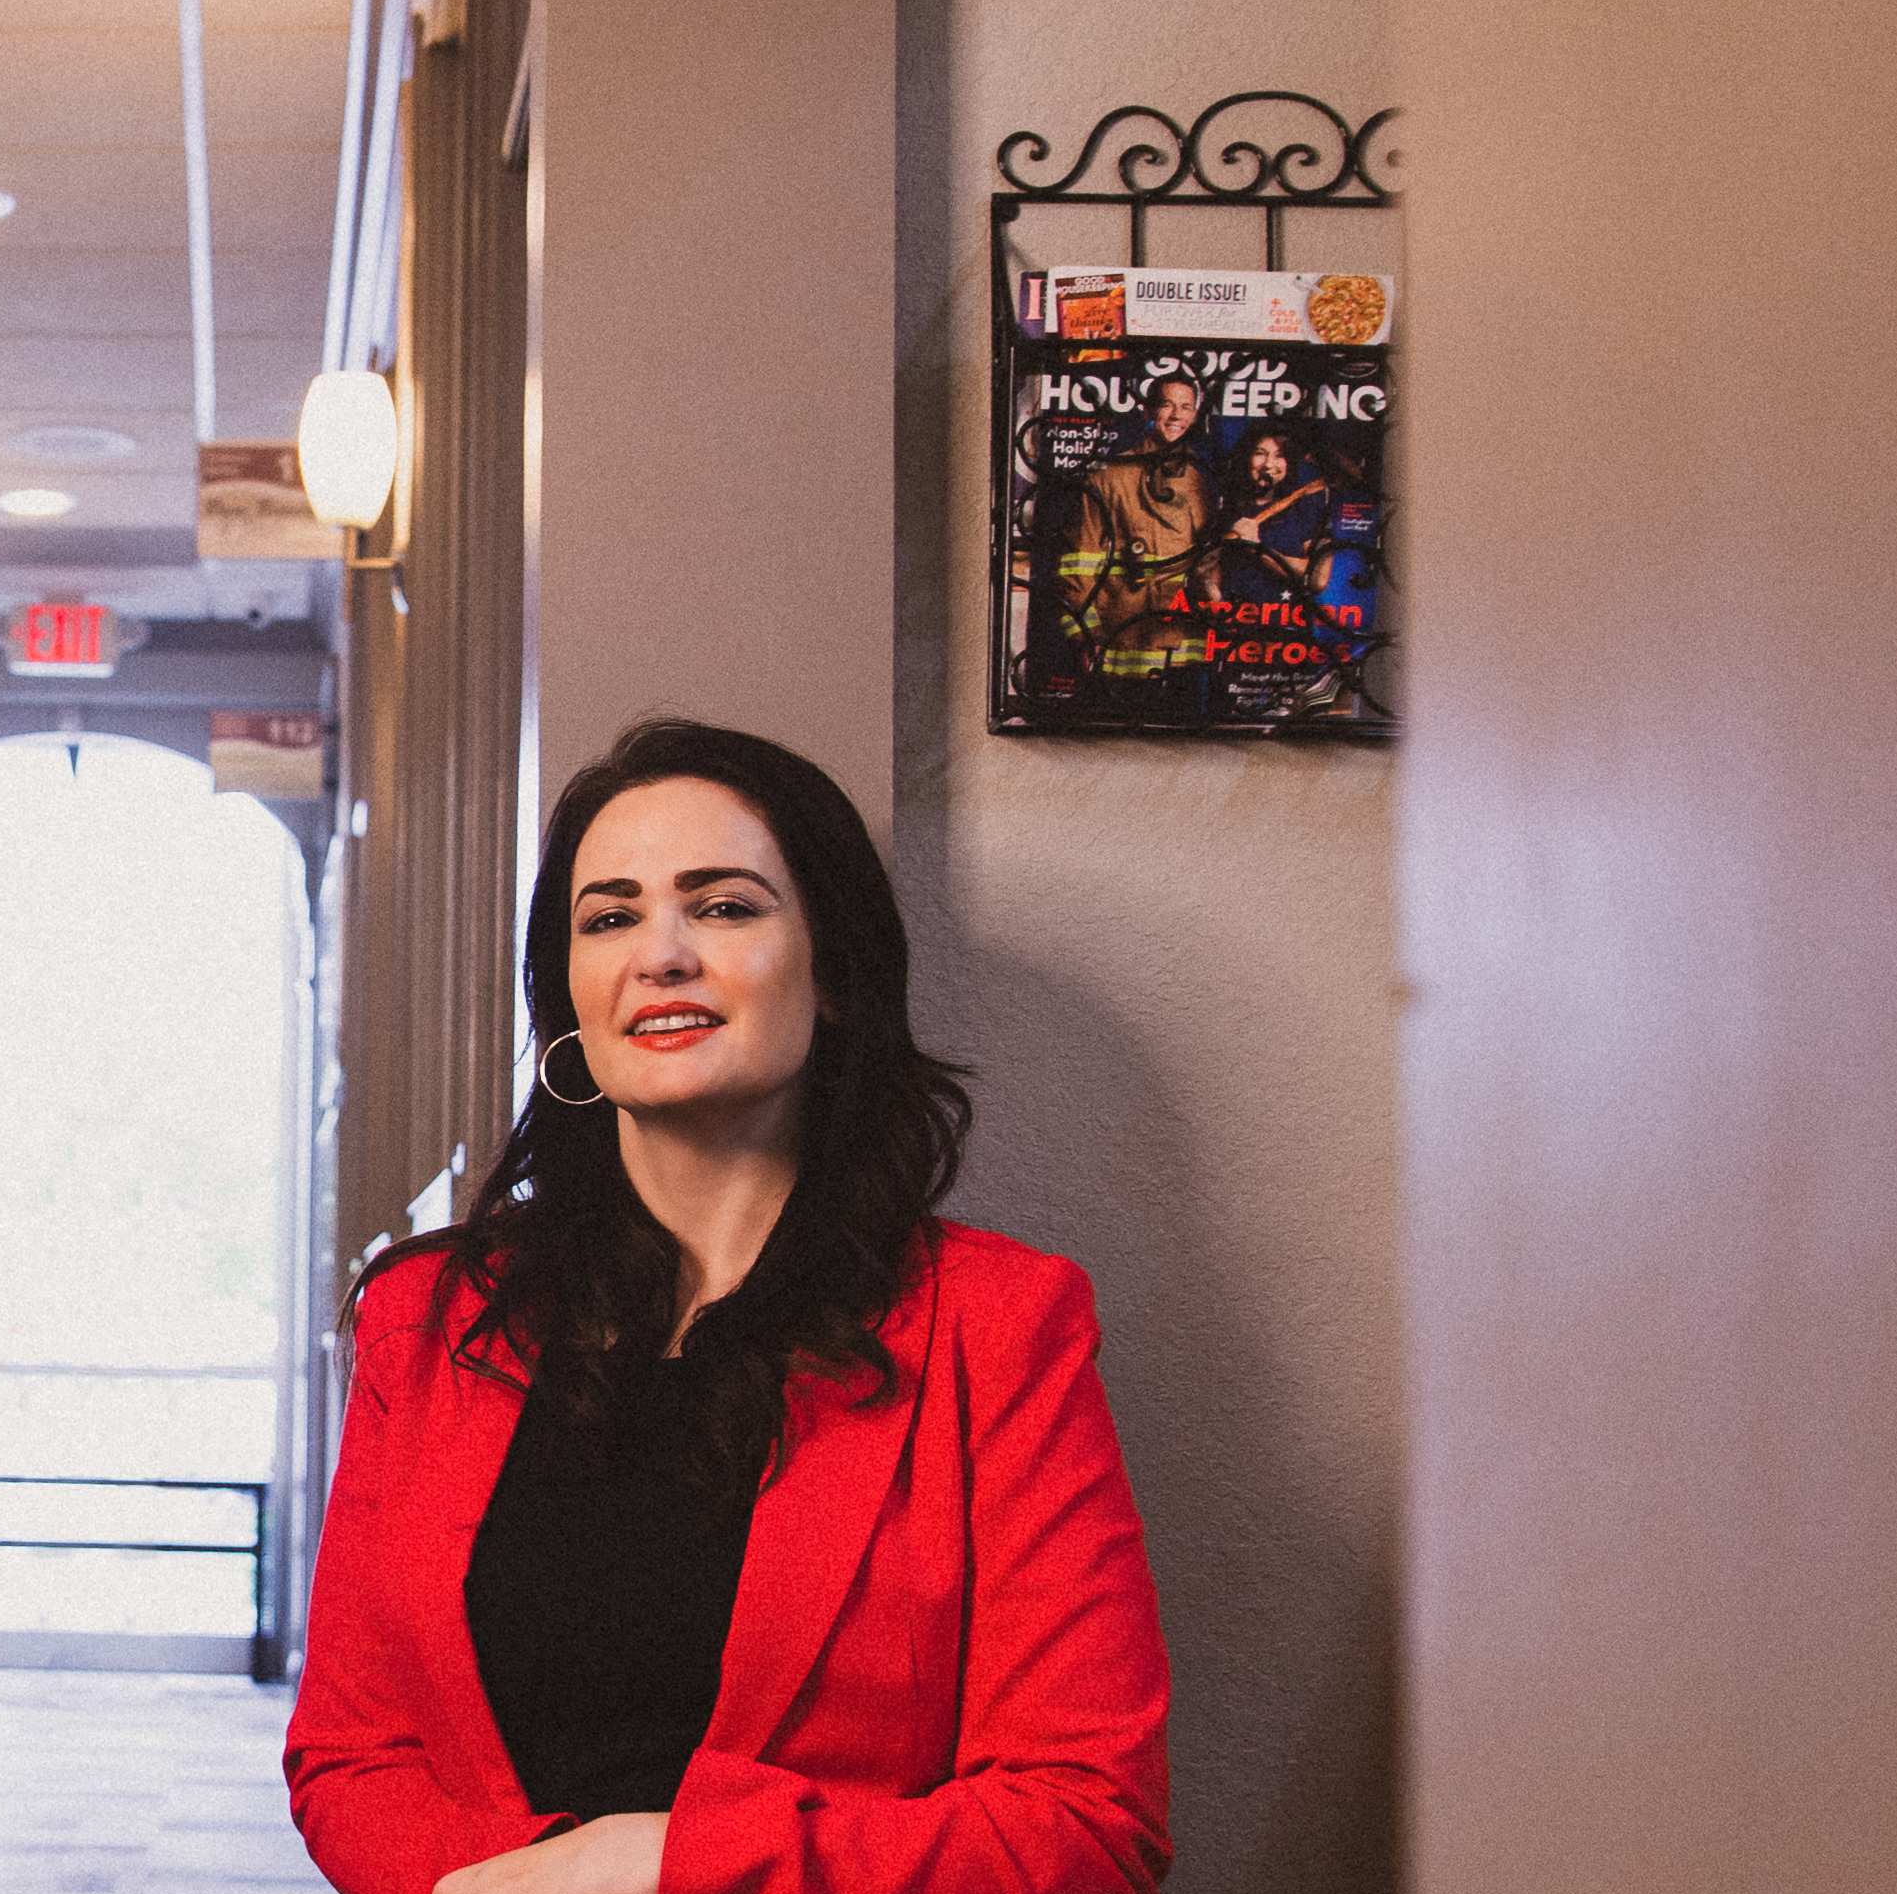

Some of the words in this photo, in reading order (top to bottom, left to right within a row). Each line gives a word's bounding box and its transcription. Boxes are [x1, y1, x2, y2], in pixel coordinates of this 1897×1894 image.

[1136, 281, 1193, 300] DOUBLE
[1199, 282, 1246, 301] ISSUE!
[25, 603, 106, 663] EXIT
